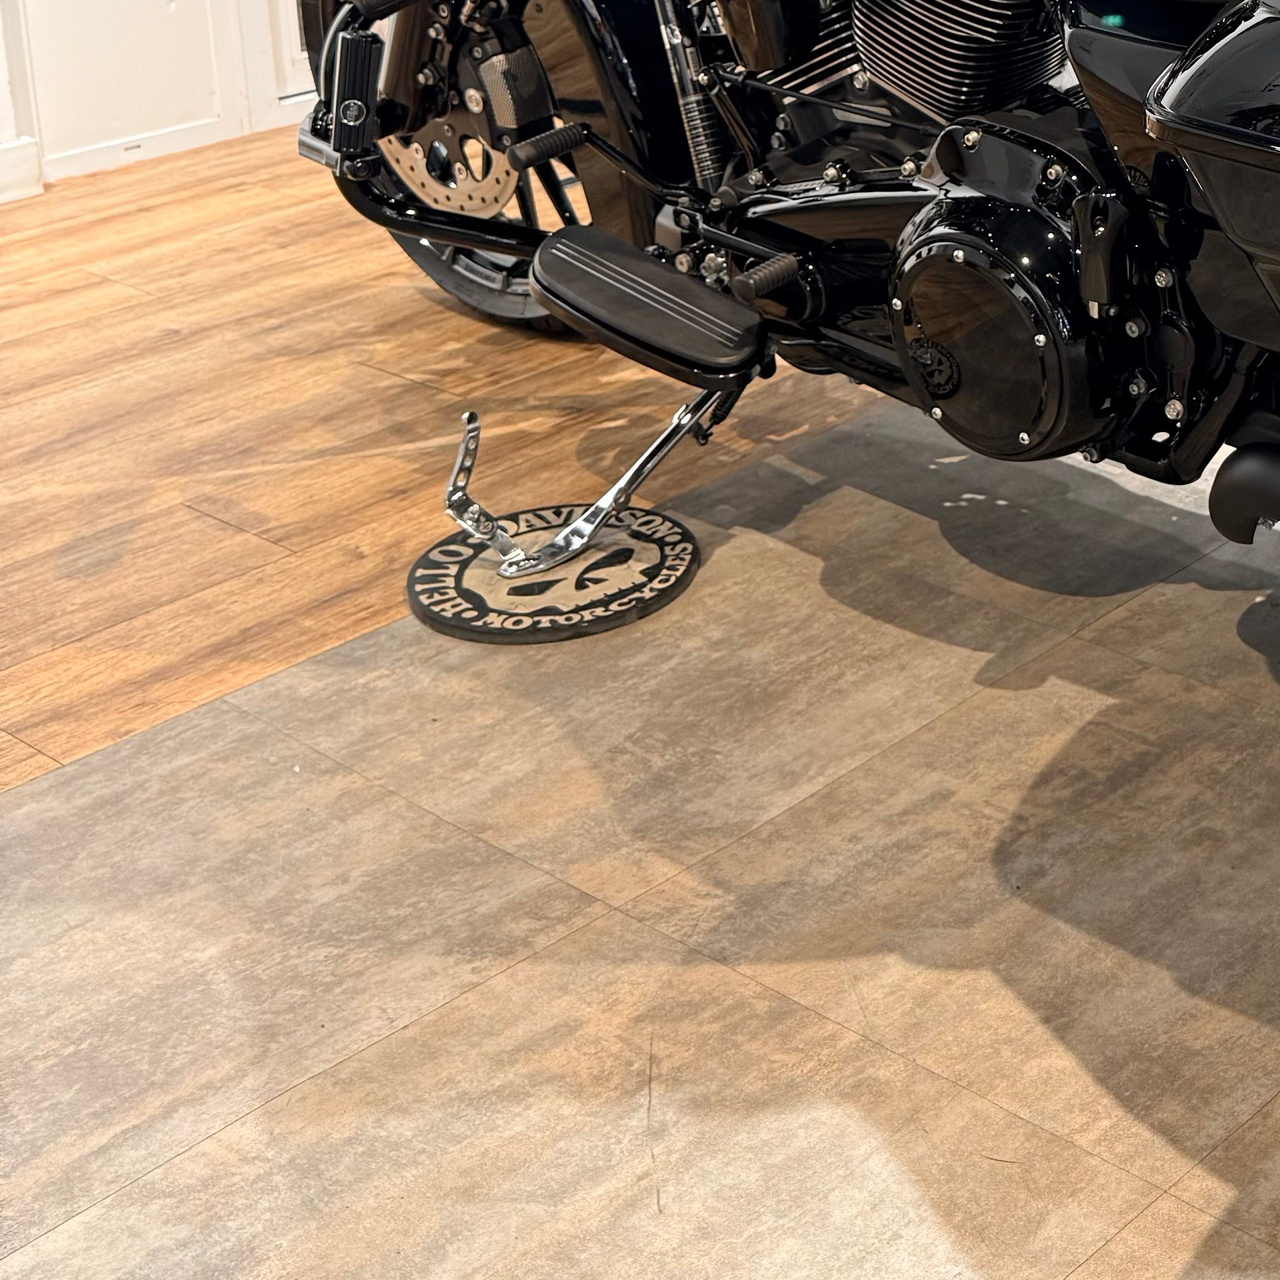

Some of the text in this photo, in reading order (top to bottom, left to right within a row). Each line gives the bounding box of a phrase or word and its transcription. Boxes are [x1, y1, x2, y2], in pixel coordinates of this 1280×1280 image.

[415, 505, 693, 630] HELLO AVISON MOTORCYCLES
